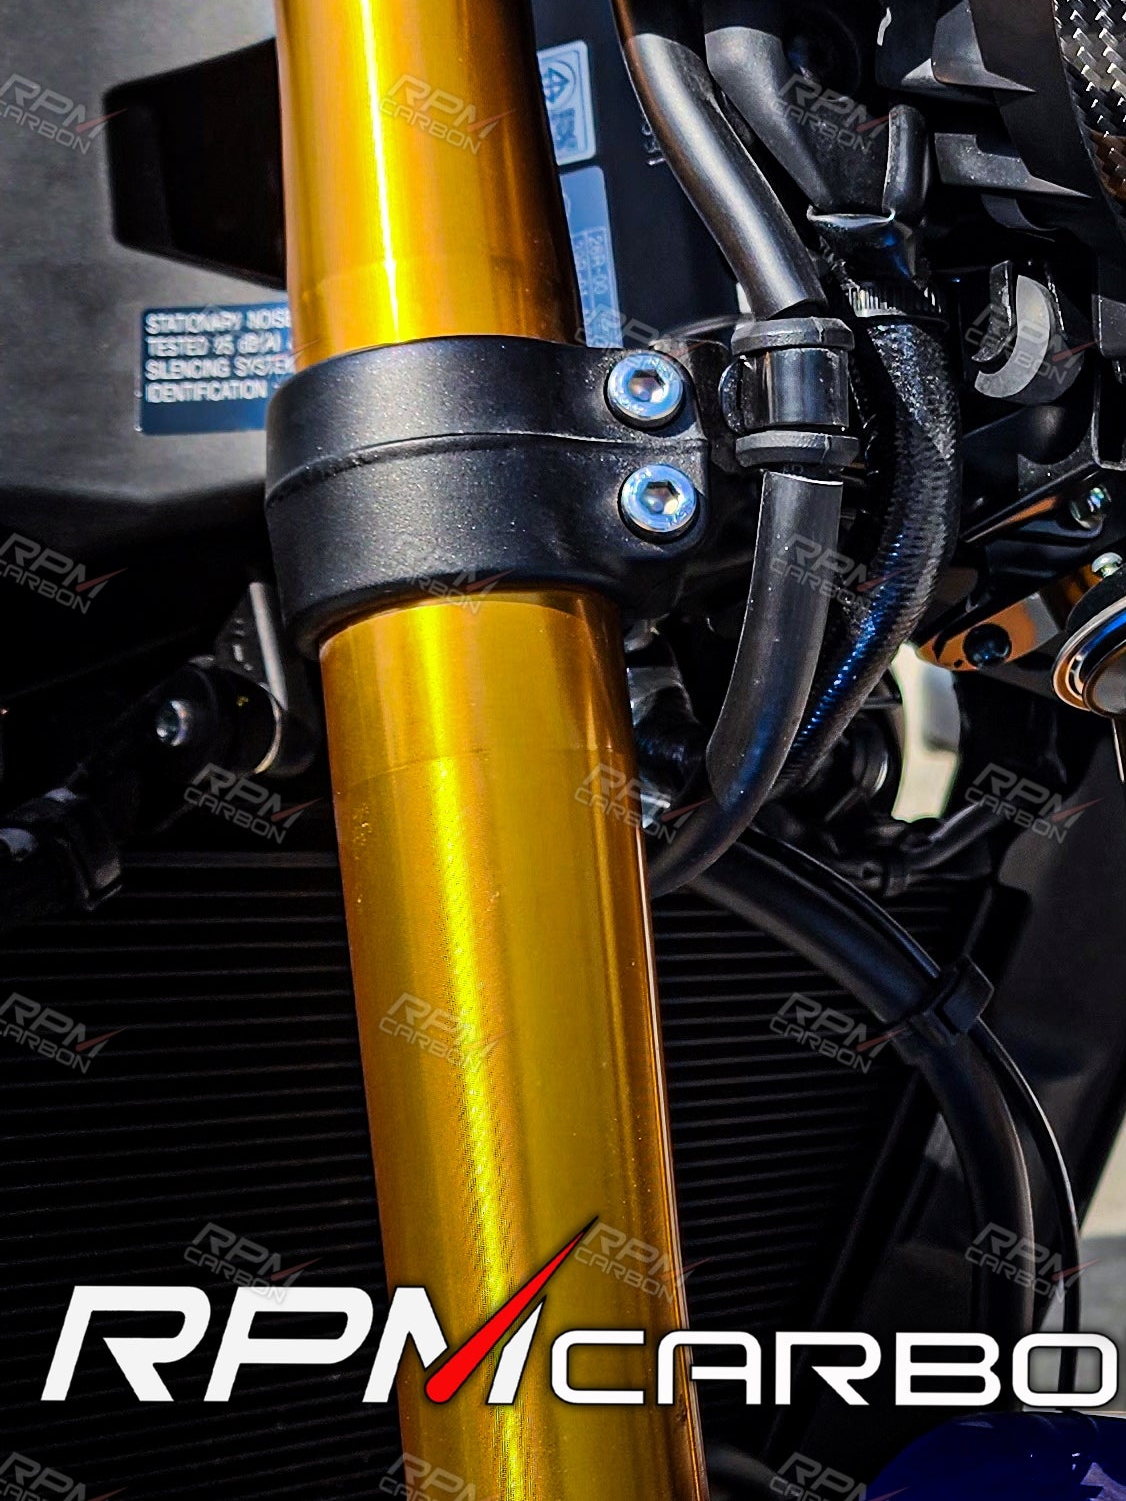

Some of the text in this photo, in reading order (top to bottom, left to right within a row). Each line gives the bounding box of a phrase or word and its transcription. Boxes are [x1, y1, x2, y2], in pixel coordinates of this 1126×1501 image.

[145, 335, 211, 357] TESTED
[145, 356, 232, 380] SILENCING
[145, 379, 268, 403] IDENTIFICATION
